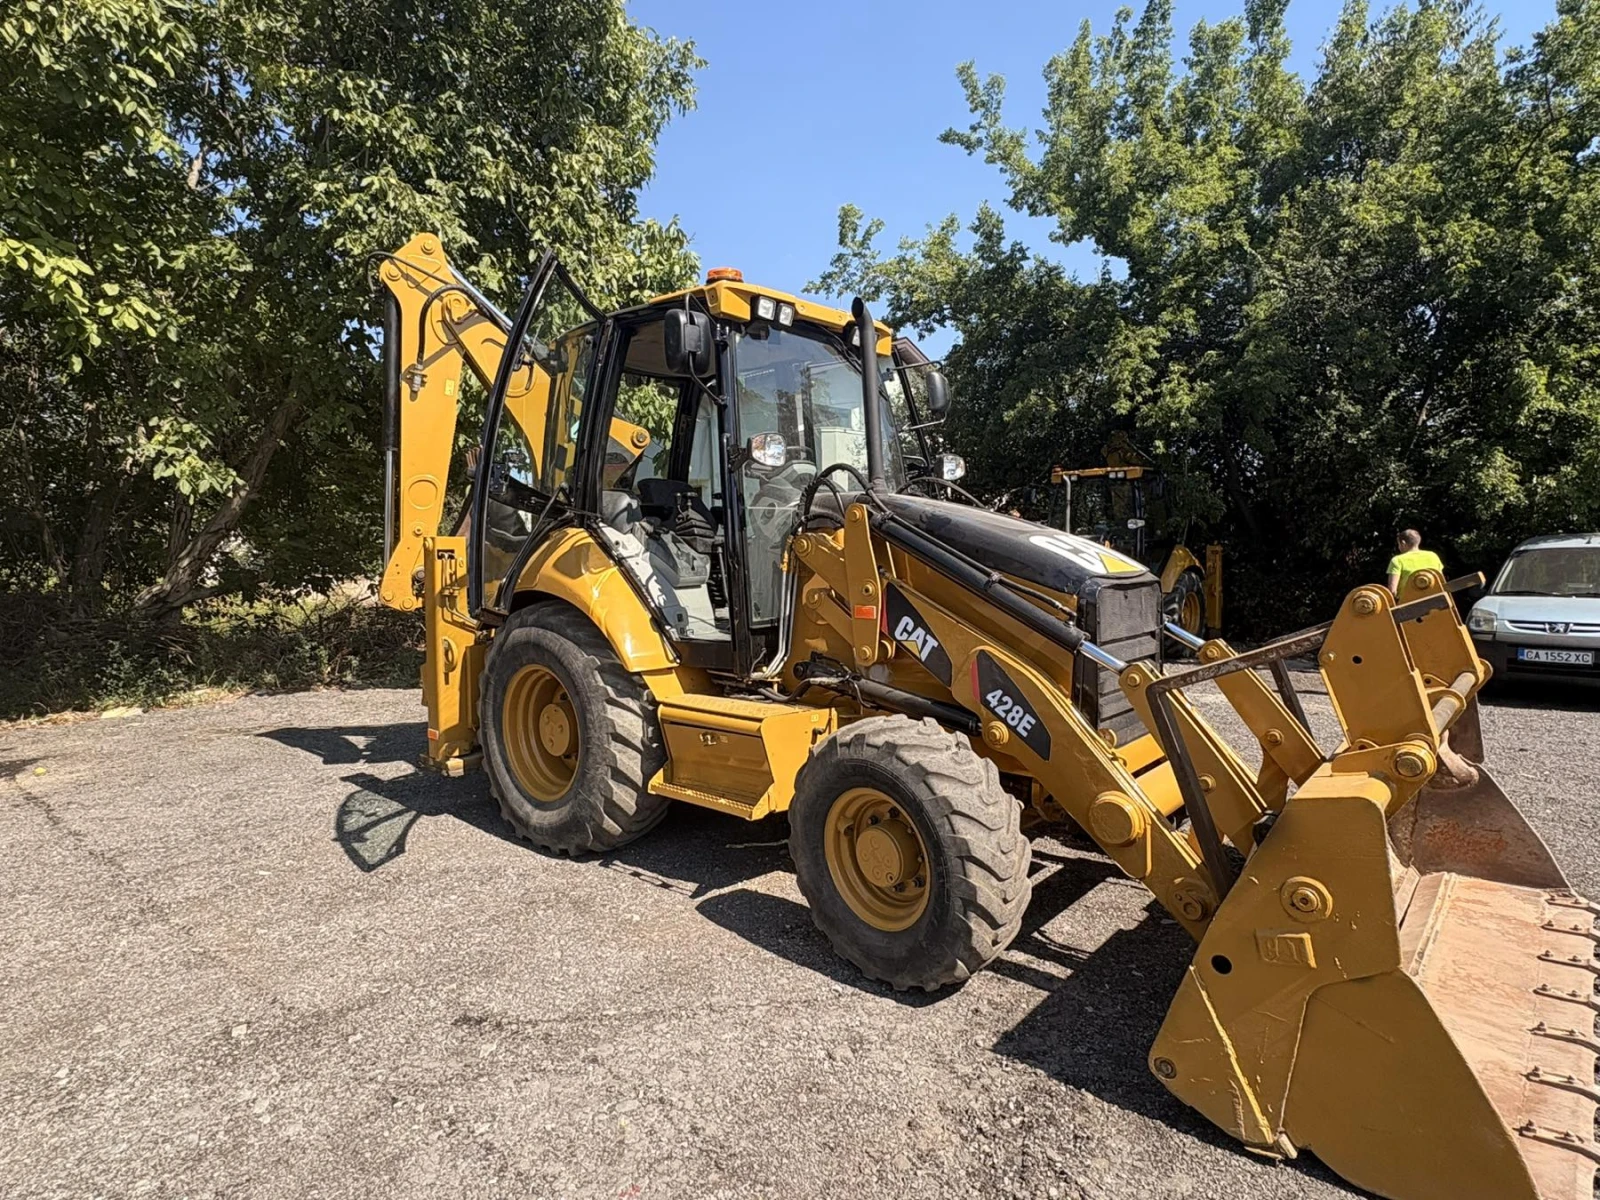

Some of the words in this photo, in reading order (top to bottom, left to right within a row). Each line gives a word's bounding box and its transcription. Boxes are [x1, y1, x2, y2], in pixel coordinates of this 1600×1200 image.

[894, 616, 938, 662] CAT
[1526, 650, 1541, 660] CA
[1545, 651, 1572, 662] 1552
[1574, 653, 1590, 663] XC
[986, 689, 1036, 738] 428E
